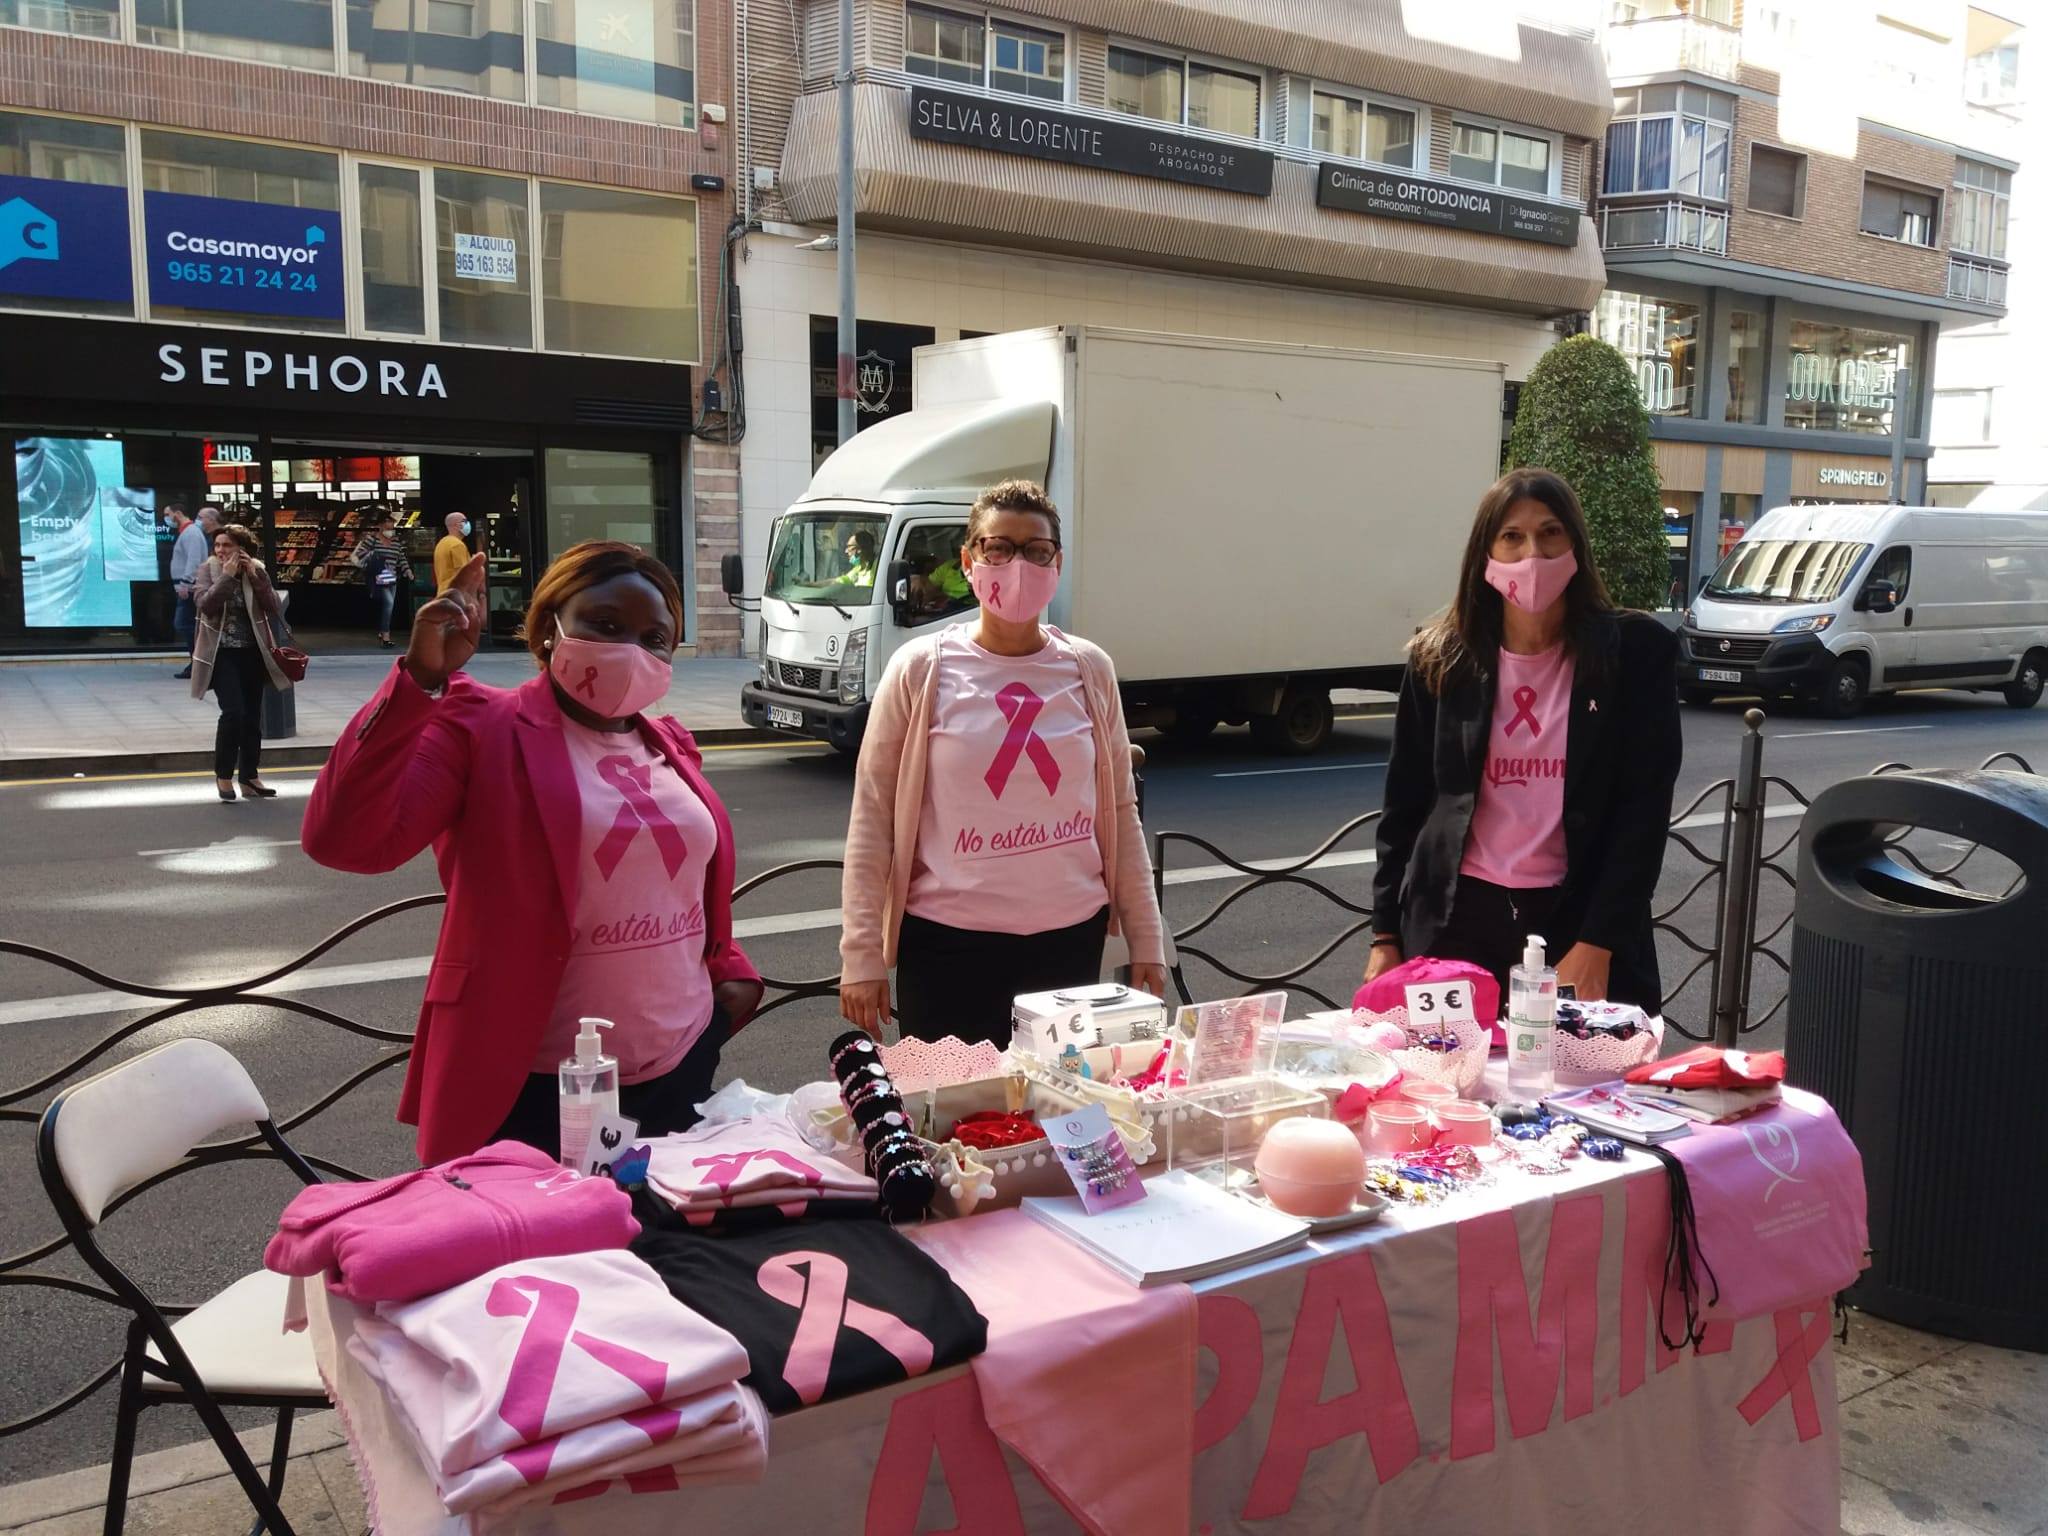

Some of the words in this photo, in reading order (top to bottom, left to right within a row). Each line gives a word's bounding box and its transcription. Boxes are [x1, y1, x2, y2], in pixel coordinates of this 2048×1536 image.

[917, 99, 983, 136] SELVA
[989, 111, 1002, 138] &
[1009, 115, 1103, 156] LORENTE
[1149, 142, 1215, 164] DESPACHO
[1219, 153, 1236, 167] DE
[1158, 157, 1225, 177] ABOGADOS
[1367, 198, 1422, 215] ORTHODONTIC
[1378, 180, 1394, 197] de
[1397, 182, 1491, 214] ORTODONCIA
[1519, 206, 1547, 221] Ignacio
[166, 230, 318, 265] Casamayor
[469, 236, 514, 253] ALQUILO
[456, 253, 474, 271] 965
[477, 256, 494, 273] 163
[497, 257, 514, 275] 554
[167, 261, 213, 284] 965
[219, 265, 245, 286] 21
[255, 268, 283, 289] 24
[289, 271, 317, 292] 24
[158, 343, 448, 399] SEPHORA
[1785, 352, 1839, 404] OOK
[216, 443, 253, 463] HUB
[1819, 468, 1887, 487] SPRINGFIELD
[31, 514, 79, 530] Empty
[143, 525, 171, 534] Empty
[829, 639, 837, 653] 3
[1703, 669, 1722, 680] 7594
[954, 826, 984, 853] No
[990, 822, 1050, 850] estás
[1053, 810, 1092, 839] sola
[590, 913, 664, 945] estás
[1418, 992, 1435, 1012] 3
[1444, 990, 1462, 1009] €
[1046, 1023, 1059, 1043] 1
[1068, 1013, 1084, 1034] €
[600, 1126, 622, 1150] €
